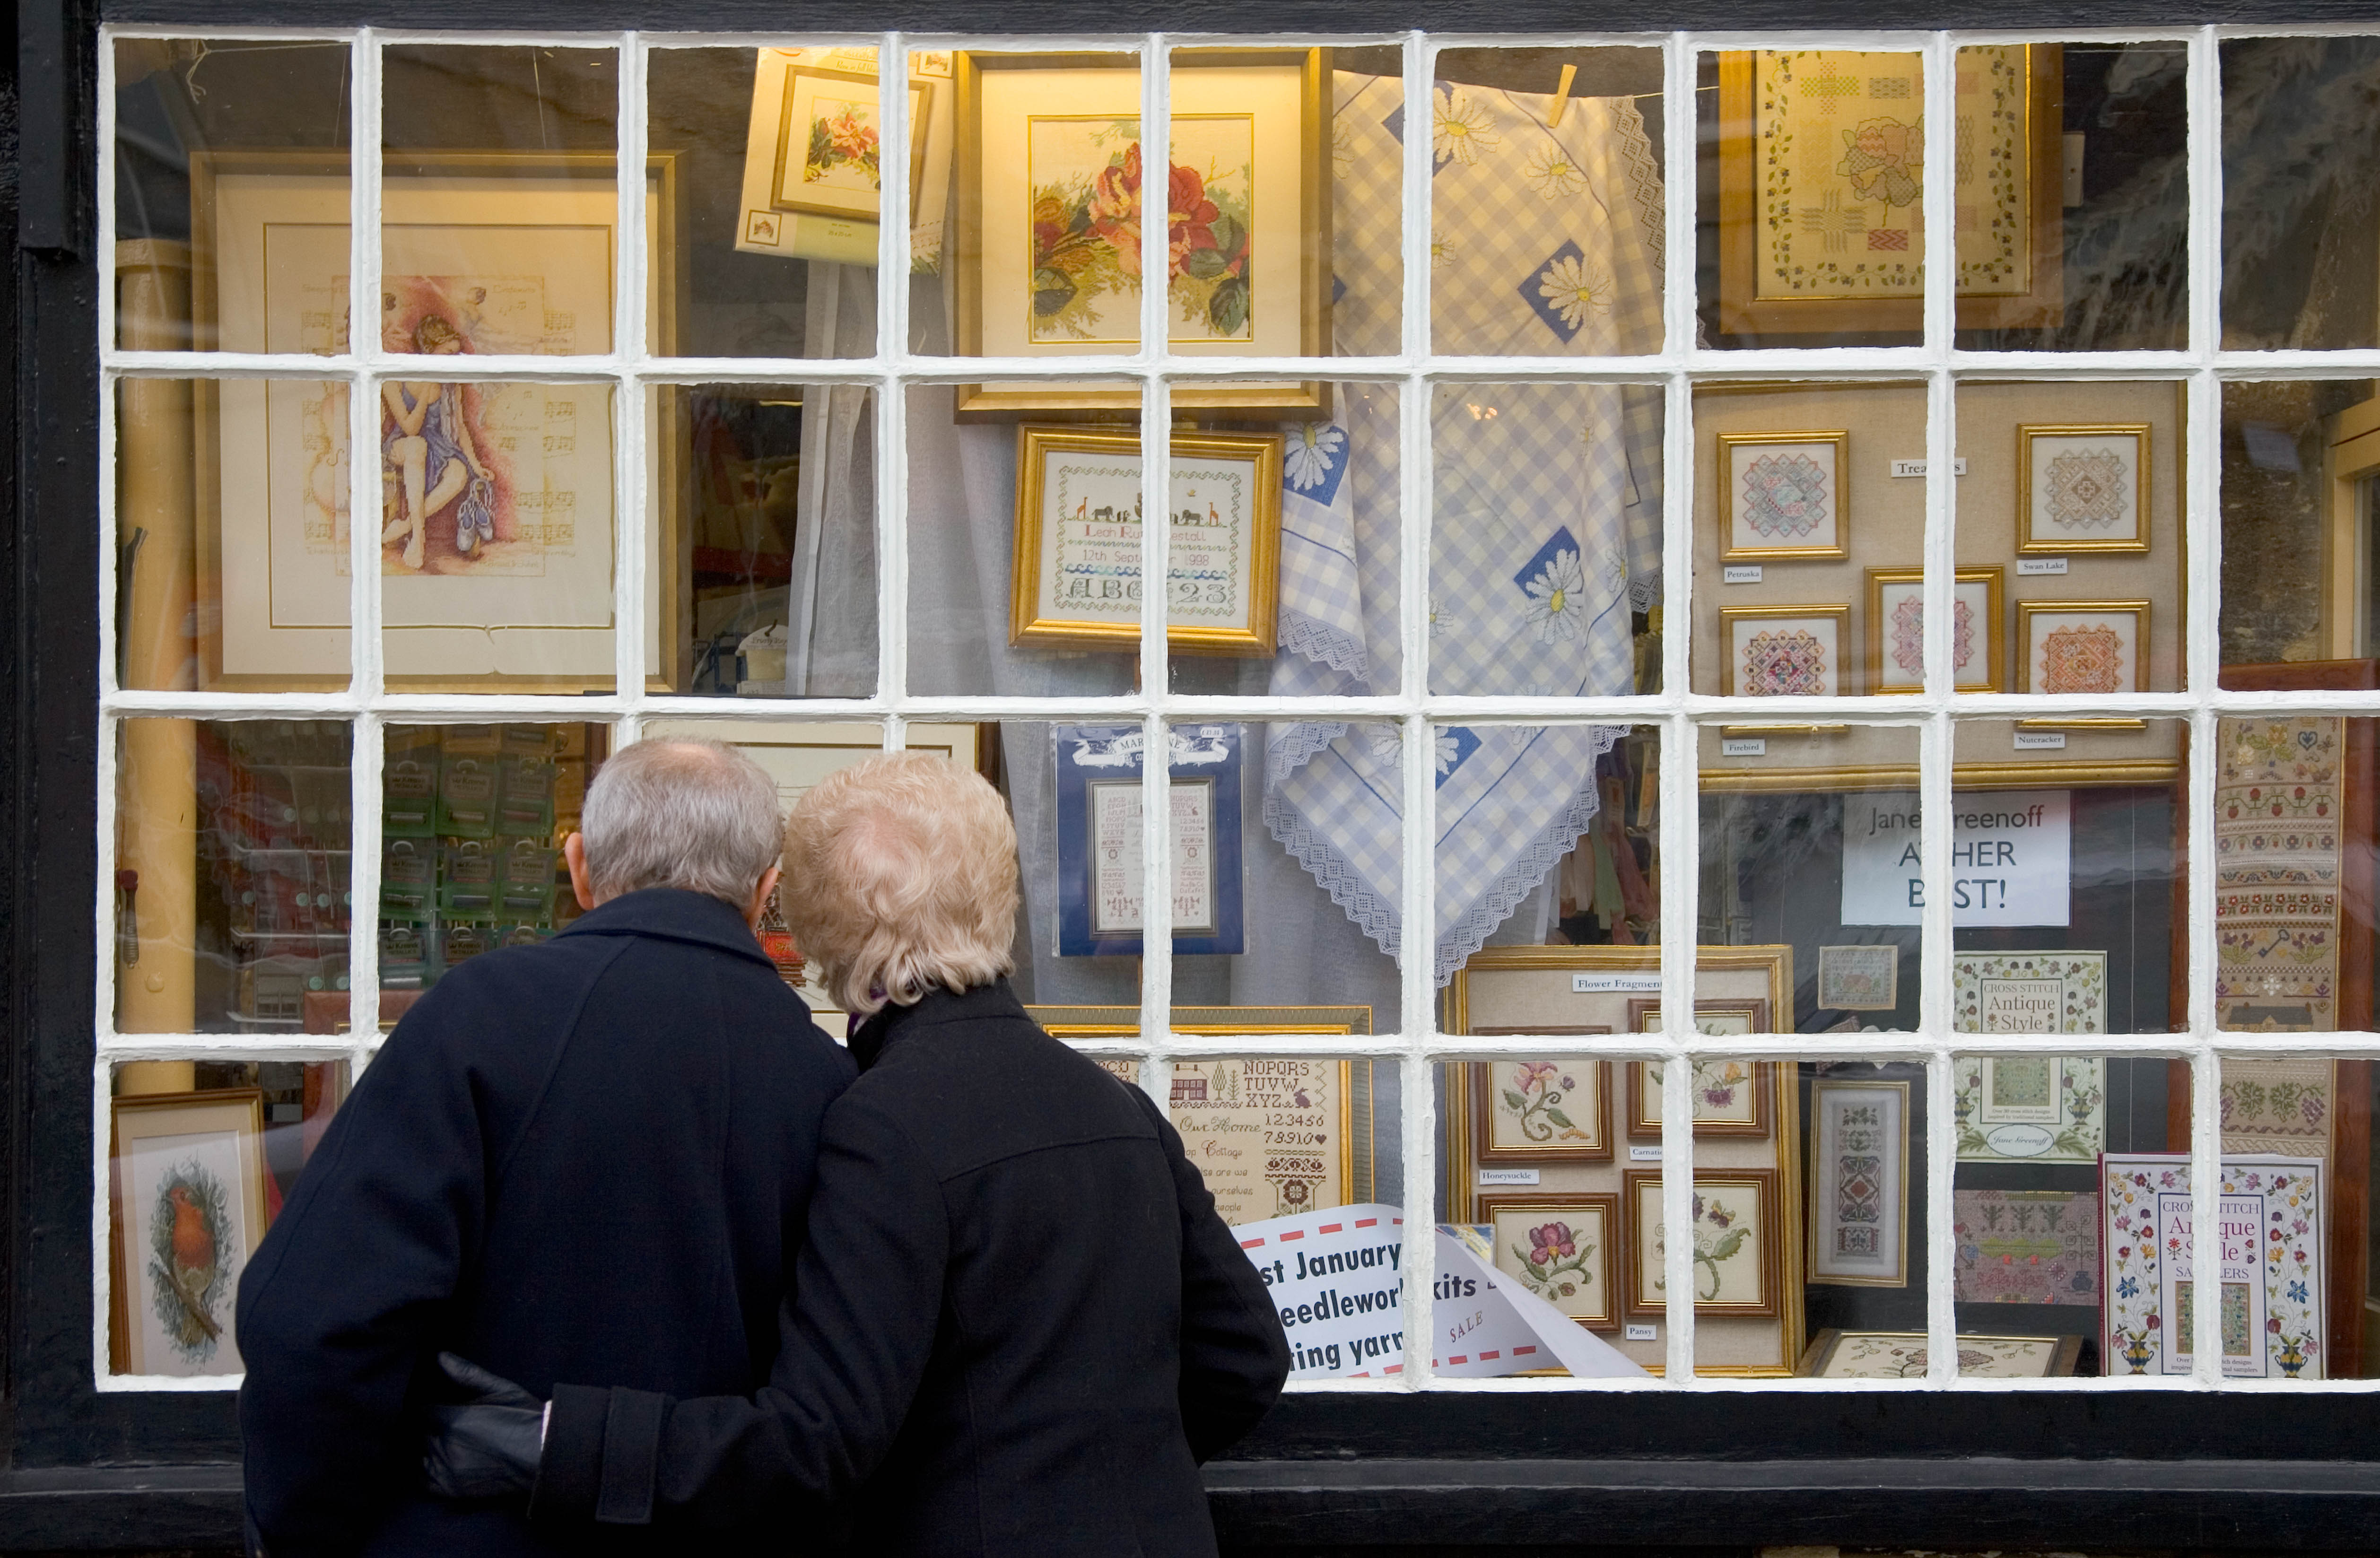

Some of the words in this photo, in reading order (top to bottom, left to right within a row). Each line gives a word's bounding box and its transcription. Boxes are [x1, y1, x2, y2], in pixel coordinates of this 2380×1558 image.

[1898, 463, 1960, 473] Treas
[1084, 524, 1116, 538] Leah
[1120, 525, 1142, 539] Ru
[1170, 531, 1206, 541] estall
[1083, 549, 1107, 561] 12th
[1115, 550, 1176, 563] Septr
[1729, 743, 1759, 751] Firebird
[1869, 807, 1921, 836] Jane
[1954, 805, 2045, 828] reenoff
[1899, 842, 1921, 867] A
[1953, 842, 2017, 867] HER
[1909, 879, 2006, 909] BST!
[1578, 979, 1611, 988] Flower
[1984, 984, 2017, 993] CROSS
[2020, 984, 2059, 993] STITCH
[1989, 995, 2056, 1014] Antique
[2001, 1014, 2043, 1034] Style
[1186, 1149, 1196, 1158] ap
[1201, 1166, 1212, 1176] lse
[1483, 1172, 1532, 1181] Honeysuckle
[1212, 1185, 1253, 1195] ourselves
[2220, 1203, 2260, 1214] TITCH
[1259, 1259, 1284, 1286] st
[1296, 1243, 1401, 1280] January
[2176, 1266, 2249, 1279] SAERS
[1280, 1278, 1404, 1327] eedlewor
[1450, 1310, 1483, 1343] SALE
[1630, 1327, 1653, 1337] Pansy
[1290, 1342, 1341, 1370] ting
